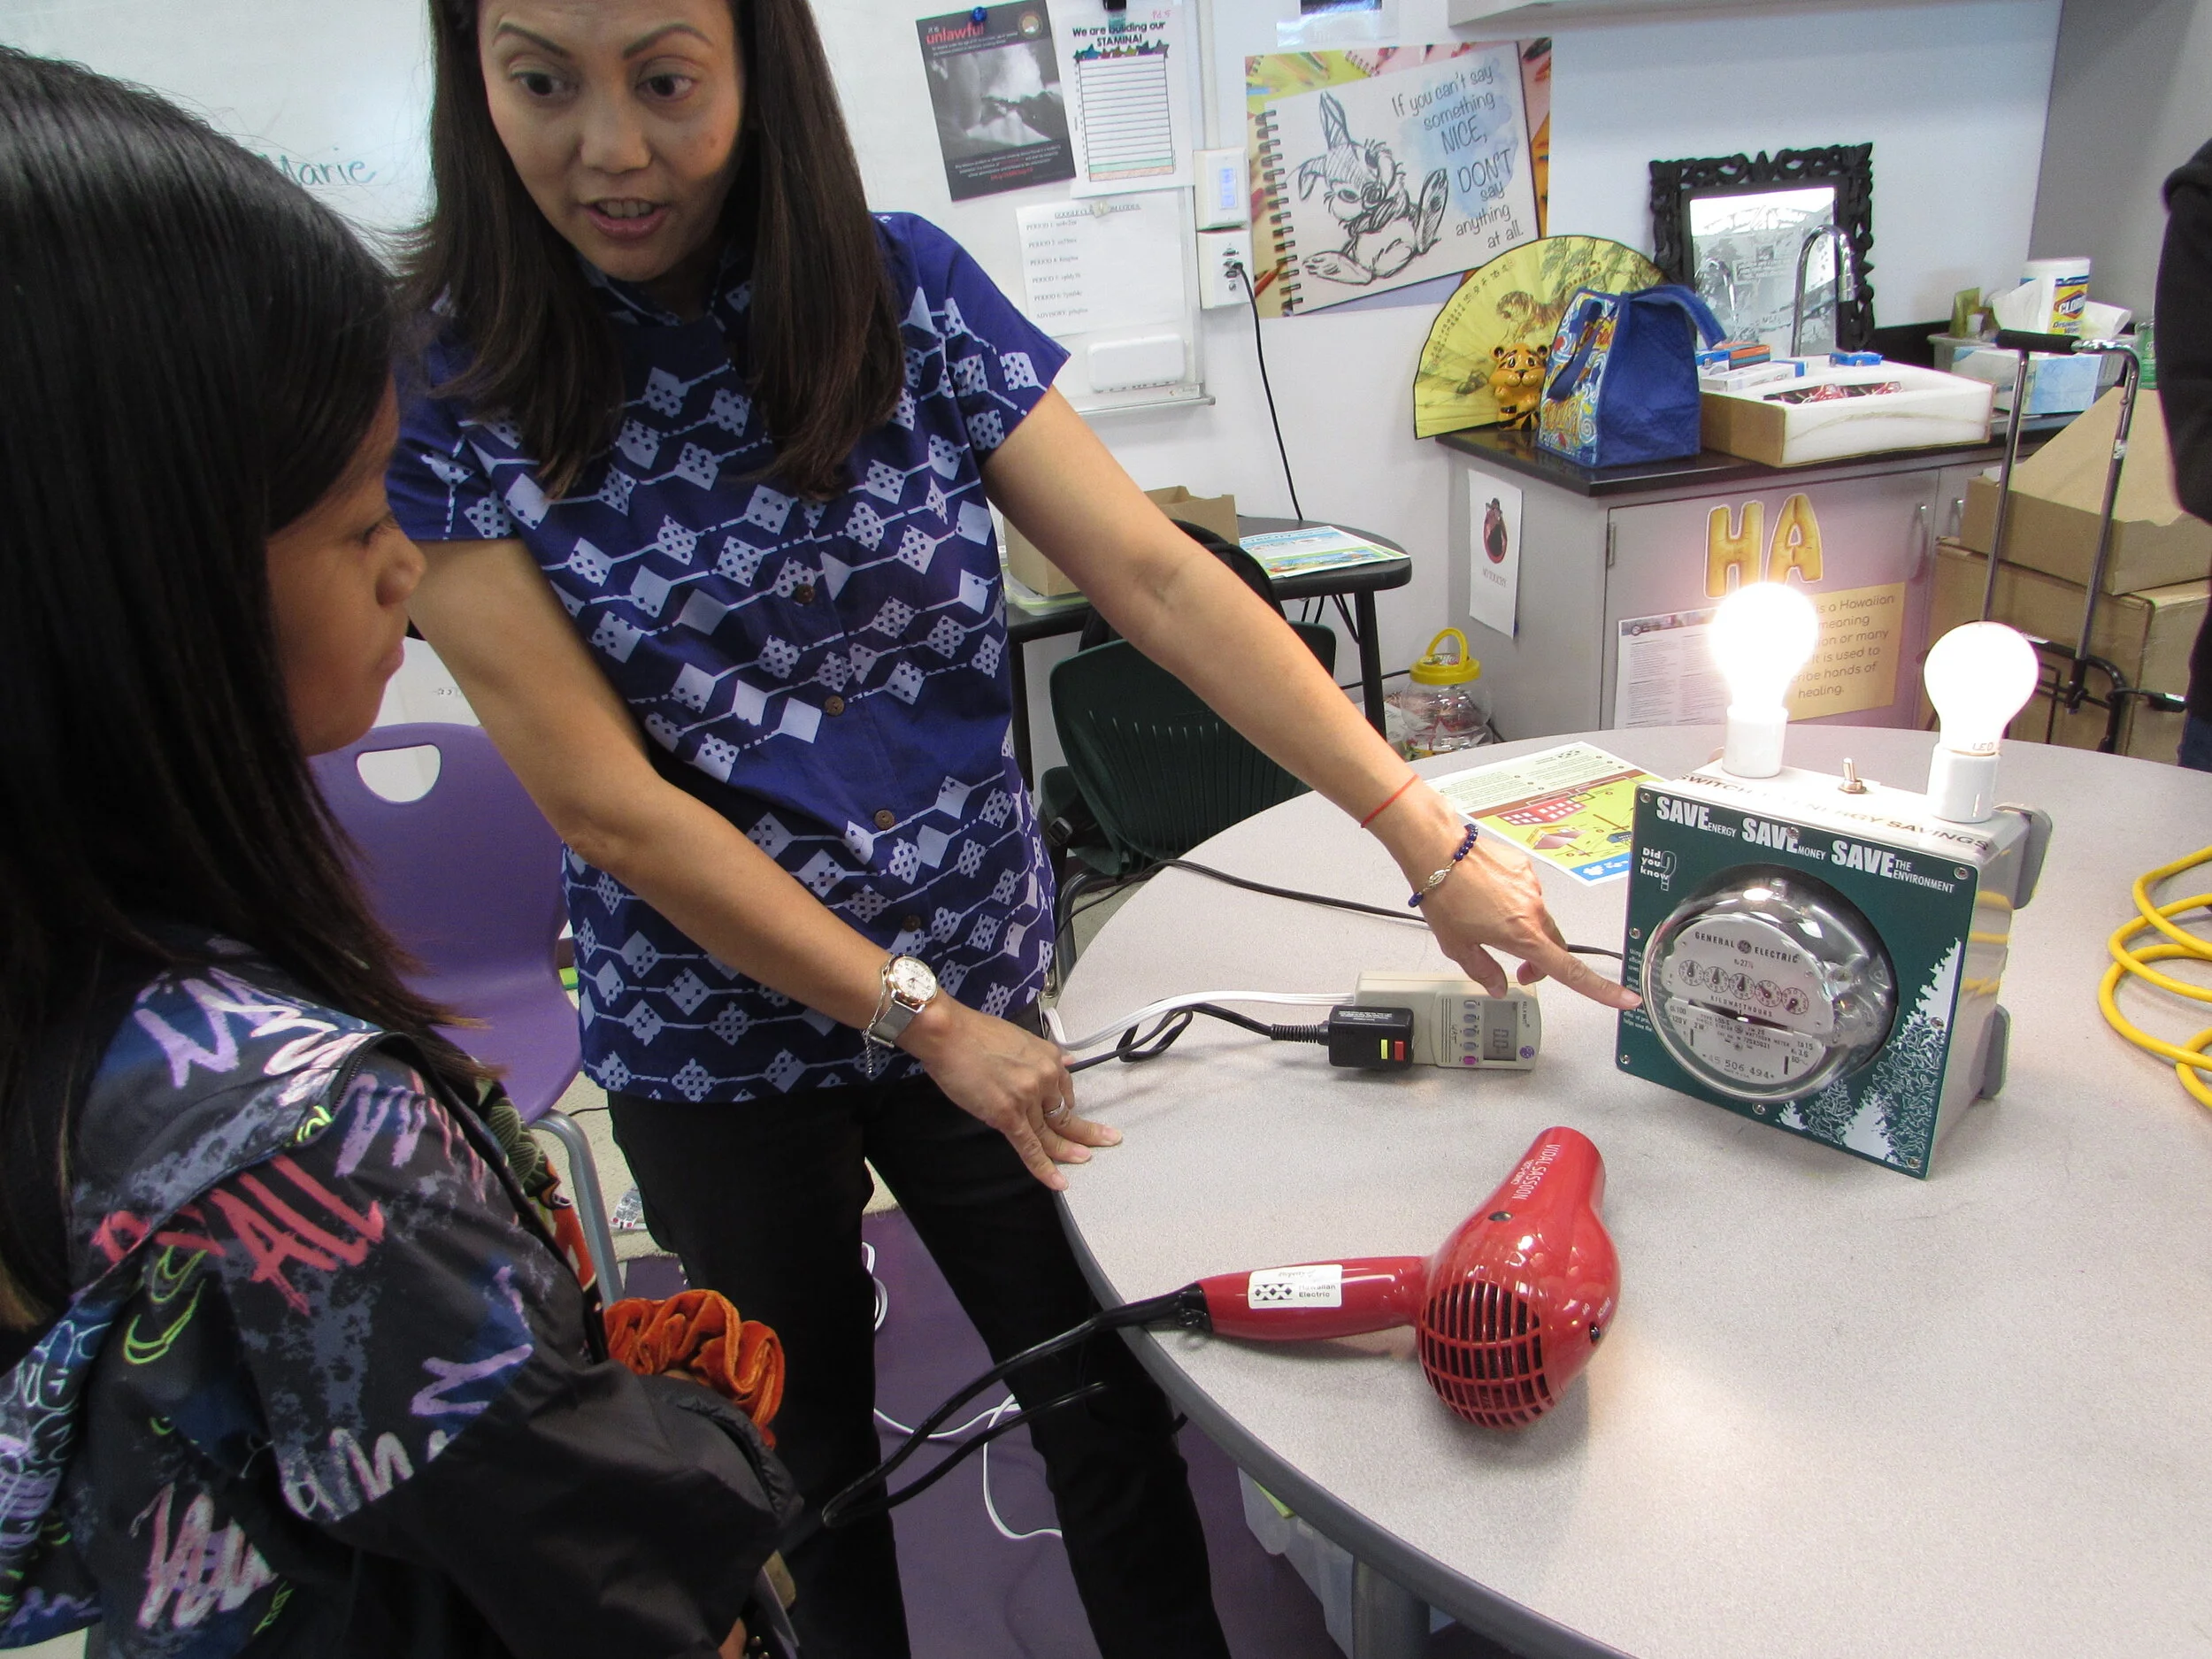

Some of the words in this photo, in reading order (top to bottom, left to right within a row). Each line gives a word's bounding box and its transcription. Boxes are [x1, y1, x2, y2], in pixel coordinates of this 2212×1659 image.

[926, 22, 985, 45] unlawful
[1072, 27, 1087, 37] We
[1089, 27, 1106, 35] are
[1108, 21, 1148, 34] building
[1149, 21, 1166, 30] our
[1096, 34, 1142, 47] STAMINA!
[1391, 93, 1405, 118] If
[1409, 92, 1432, 117] you
[1435, 72, 1466, 100] can't
[1470, 65, 1494, 85] say
[1423, 92, 1496, 131] something
[1441, 115, 1487, 155] NICE,
[257, 147, 376, 186] Marie
[1456, 149, 1512, 194] DON'T
[1479, 181, 1505, 202] say
[1455, 204, 1512, 236] anything
[1487, 230, 1500, 250] at
[1506, 219, 1524, 242] all.
[1704, 493, 1824, 599] HA
[1828, 603, 1837, 612] a
[1839, 595, 1894, 611] Hawaiian
[1839, 634, 1854, 644] or
[1855, 629, 1889, 642] many
[1823, 652, 1833, 663] is
[1836, 648, 1865, 660] used
[1868, 646, 1880, 657] to
[1824, 664, 1861, 679] hands
[1864, 661, 1878, 672] of
[1798, 684, 1845, 699] healing.
[1972, 741, 1994, 751] LED
[1656, 796, 1710, 831] SAVE
[1708, 820, 1736, 838] ENERGY
[1679, 772, 1753, 795] SWITCH
[1886, 819, 1990, 851] SAVINGS
[1741, 817, 1800, 855] SAVE
[1798, 845, 1826, 861] MONEY
[1641, 856, 1661, 868] you
[1642, 847, 1661, 860] Did
[1832, 840, 1895, 879] SAVE
[1895, 859, 1912, 872] THE
[1640, 865, 1670, 881] know
[1893, 867, 1955, 894] ENVIRONMENT
[1694, 931, 1734, 949] GENERAL
[1755, 947, 1800, 964] ELECTRIC
[1709, 995, 1772, 1018] KILOWATTHOURS
[1725, 1060, 1745, 1071] 506
[1749, 1067, 1770, 1079] 494
[1535, 1143, 1561, 1165] VIDAL
[1511, 1166, 1547, 1200] SASSOON
